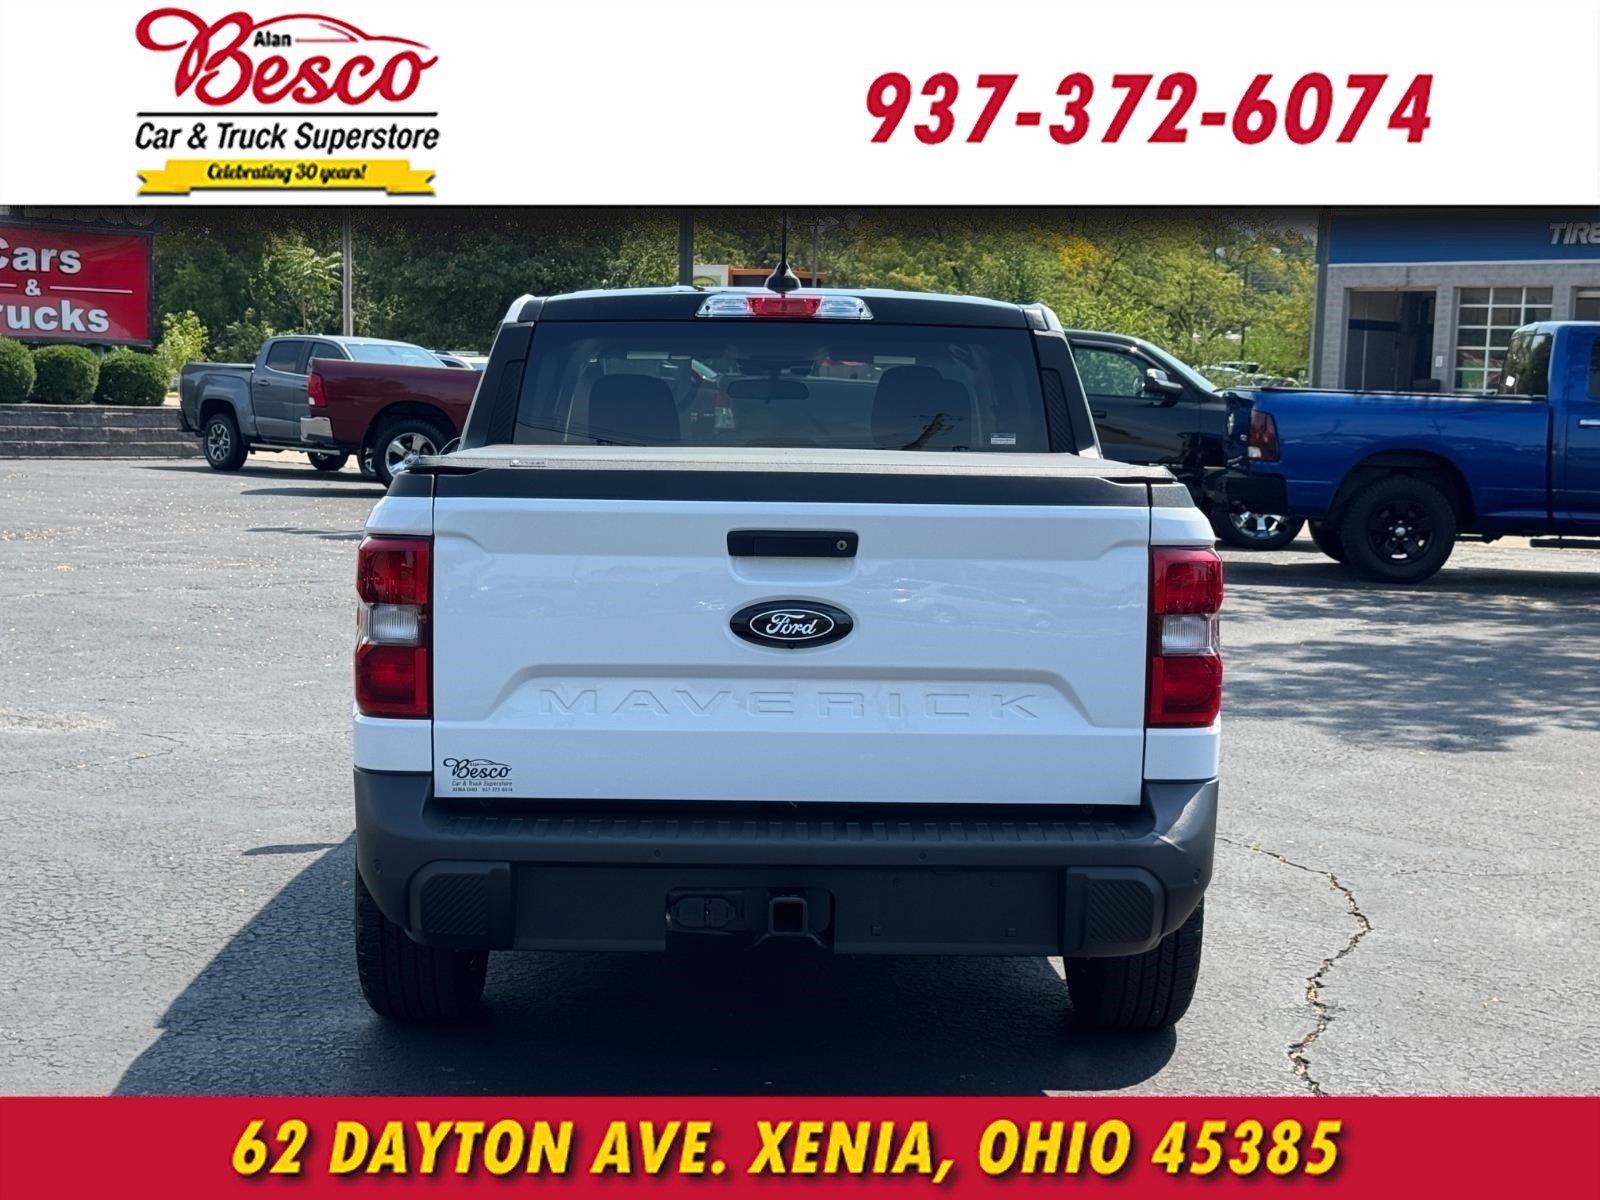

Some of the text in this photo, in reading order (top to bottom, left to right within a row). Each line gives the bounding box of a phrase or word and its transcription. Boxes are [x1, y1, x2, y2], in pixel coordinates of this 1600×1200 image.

[25, 279, 42, 296] &
[0, 300, 110, 333] ucks
[766, 613, 818, 635] Ford
[539, 687, 1040, 721] MAVERICK
[443, 758, 513, 778] Besco
